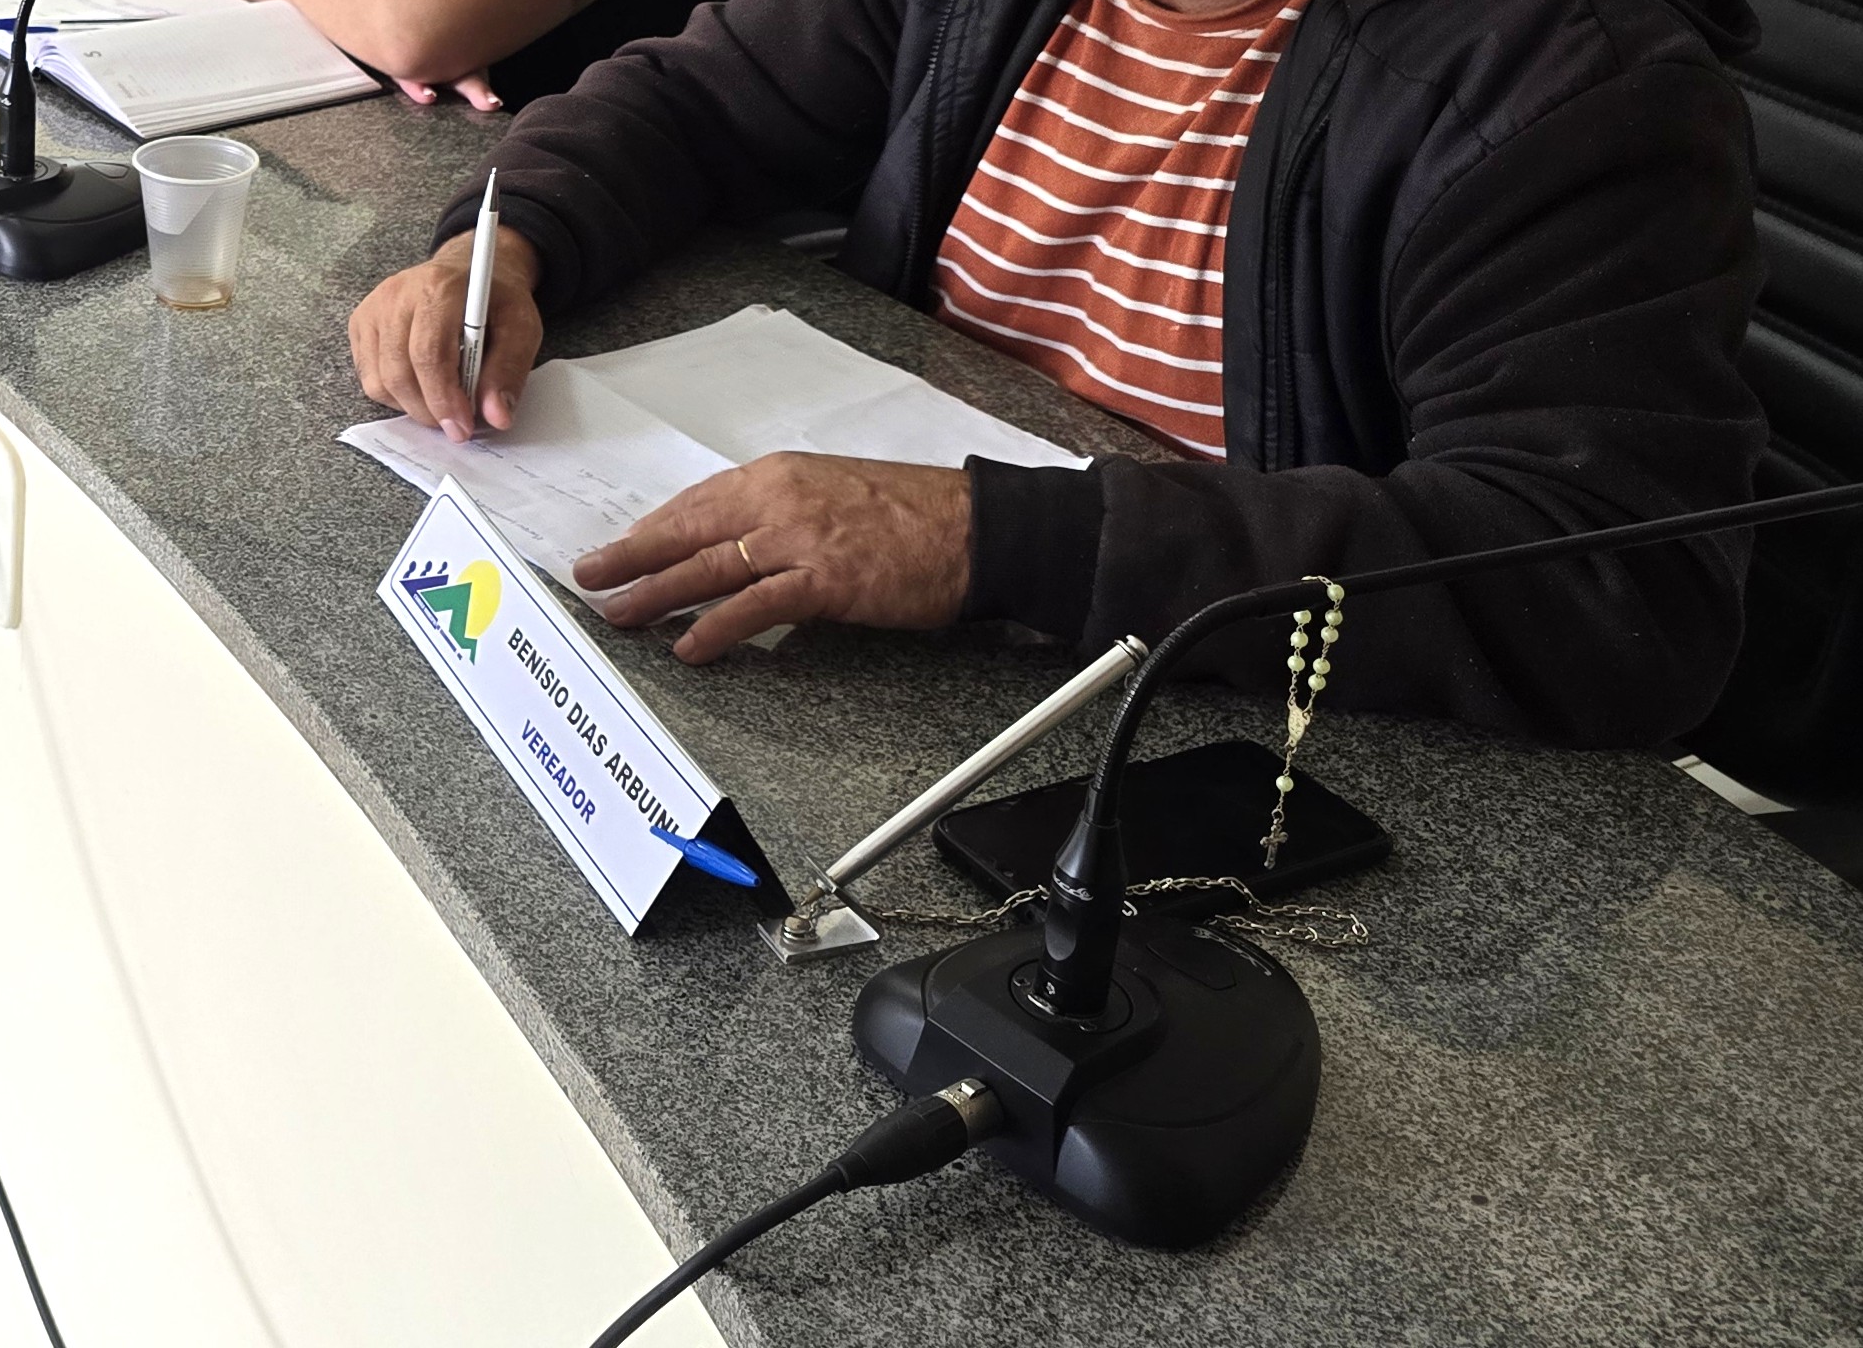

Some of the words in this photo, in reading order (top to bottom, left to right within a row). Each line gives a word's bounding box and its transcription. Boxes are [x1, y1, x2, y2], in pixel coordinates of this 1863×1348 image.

[507, 627, 569, 708] BENÍSIO
[566, 702, 608, 757] DIAS
[521, 718, 597, 825] VEREADOR
